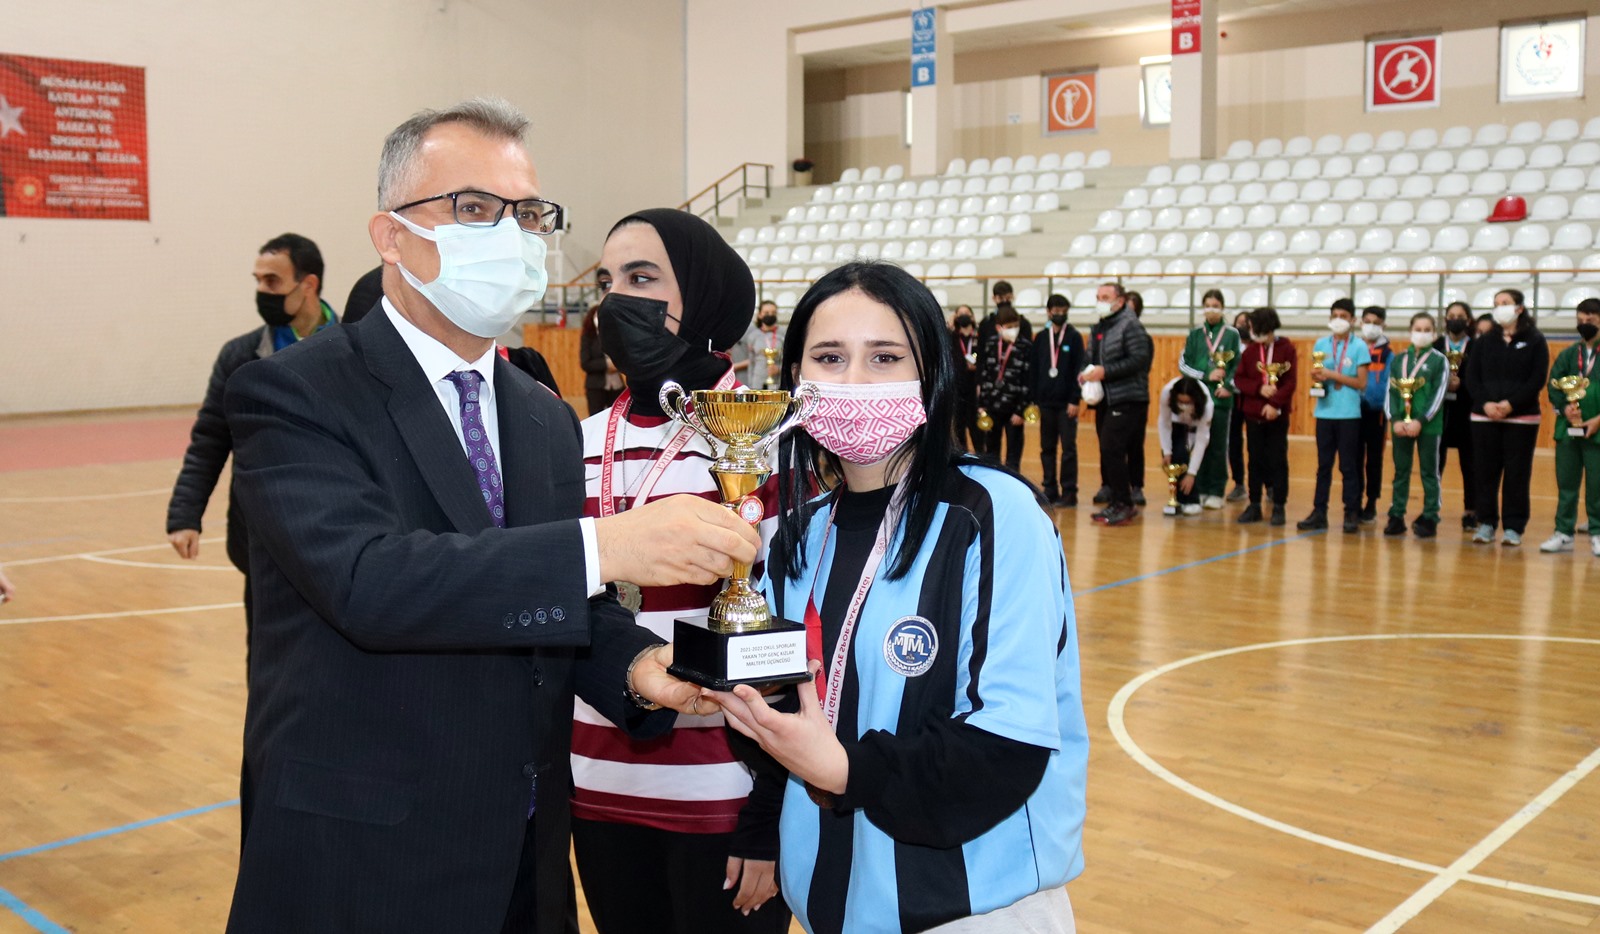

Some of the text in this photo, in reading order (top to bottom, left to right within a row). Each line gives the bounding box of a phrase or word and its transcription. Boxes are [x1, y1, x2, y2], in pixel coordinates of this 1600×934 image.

[1179, 32, 1194, 50] B
[917, 67, 930, 83] B
[98, 124, 112, 135] VE
